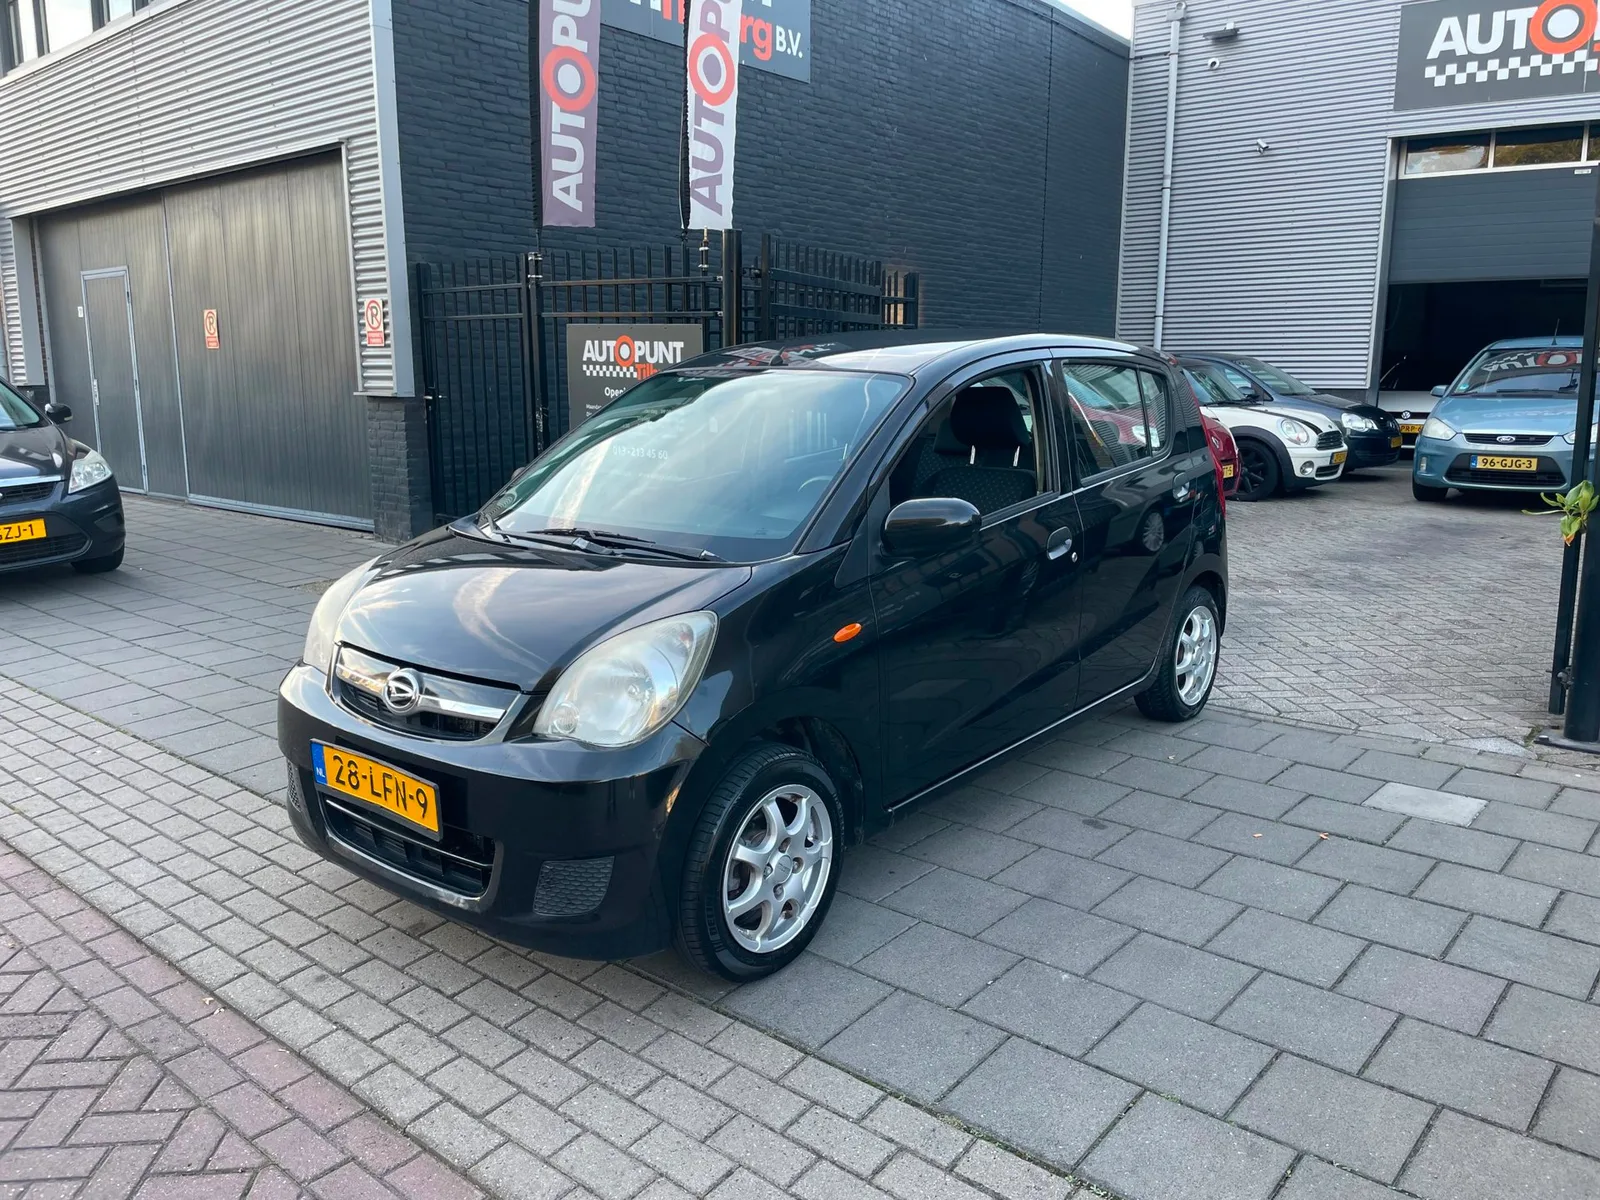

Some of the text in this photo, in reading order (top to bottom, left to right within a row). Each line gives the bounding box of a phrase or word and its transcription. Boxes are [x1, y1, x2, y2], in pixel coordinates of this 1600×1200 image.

[775, 25, 803, 59] B.V.
[582, 334, 684, 368] AUTOPUNT
[1481, 457, 1533, 469] 96-GJG-3
[316, 766, 326, 778] NL
[332, 755, 428, 819] 28-LFN-9
